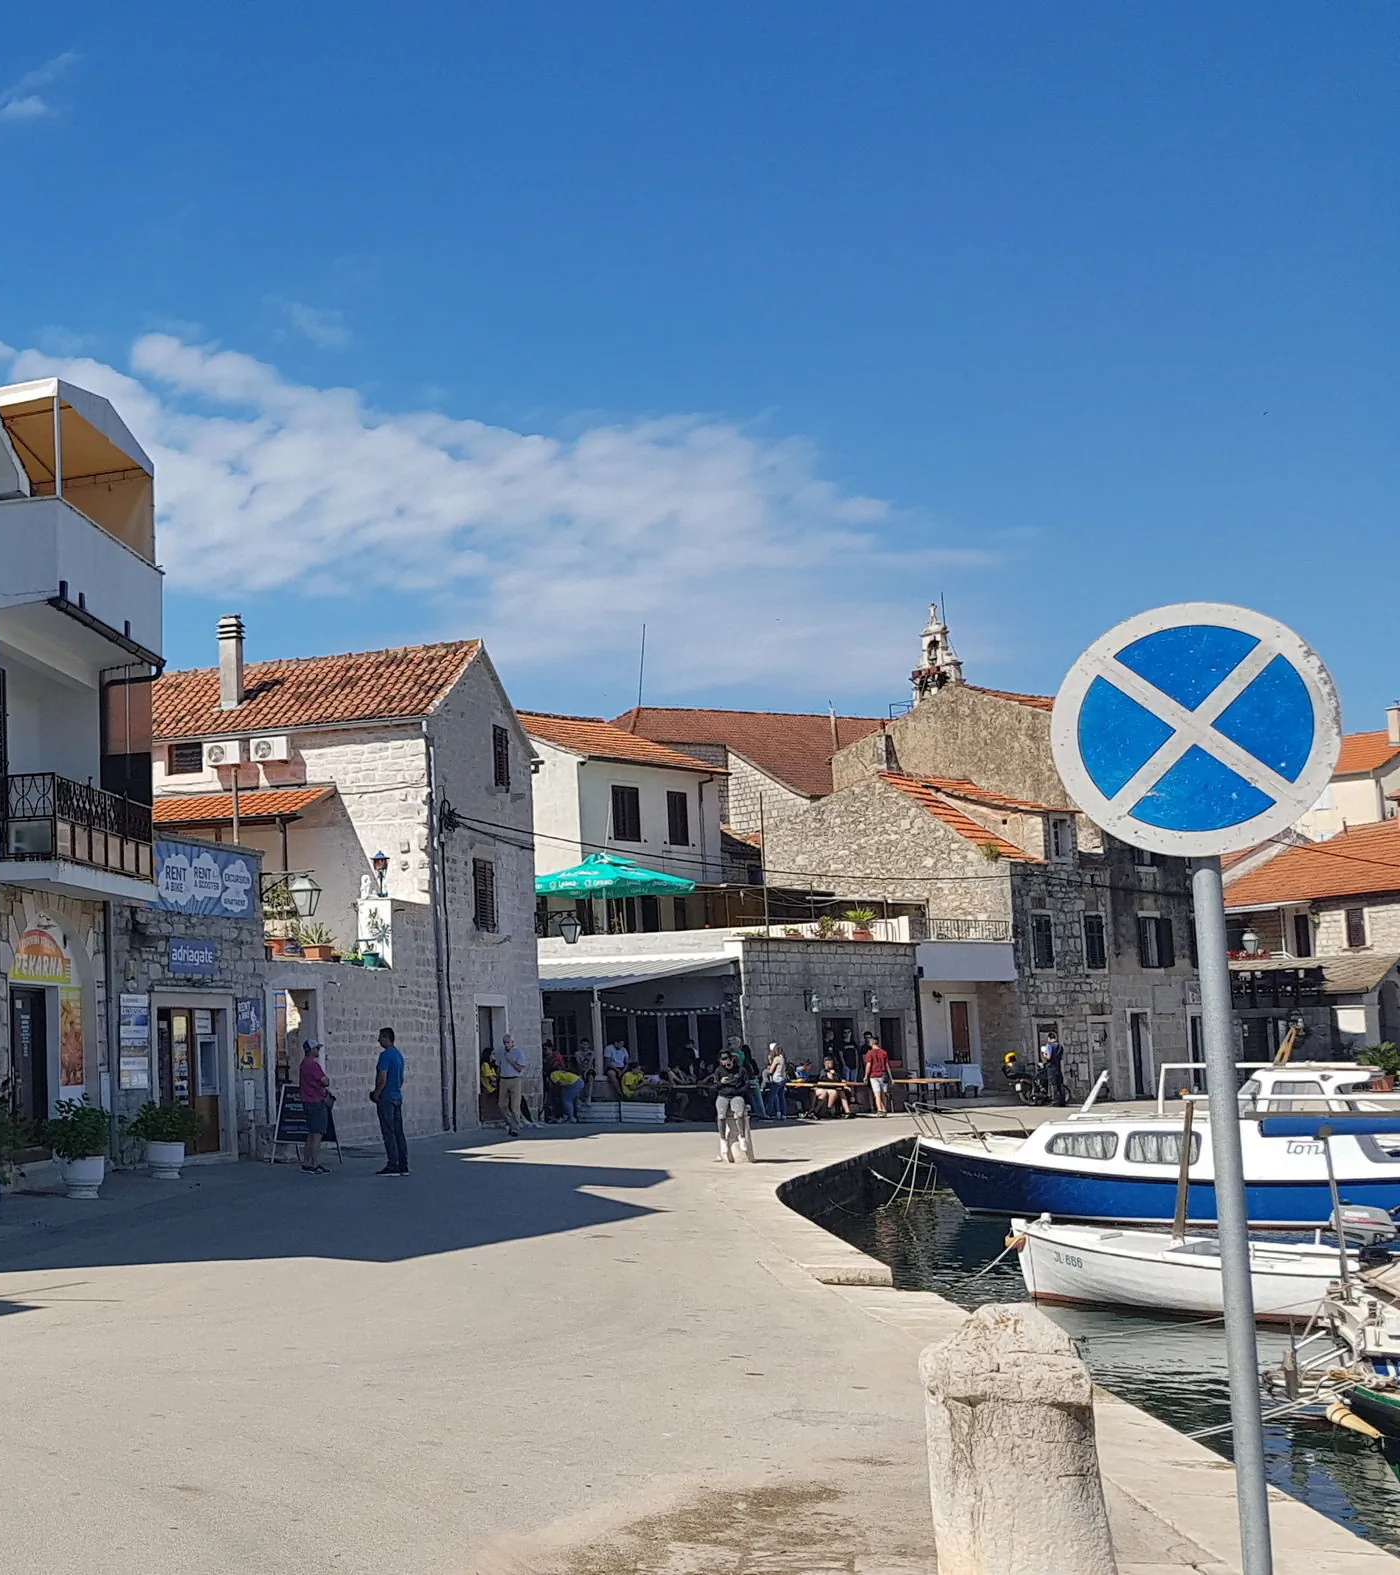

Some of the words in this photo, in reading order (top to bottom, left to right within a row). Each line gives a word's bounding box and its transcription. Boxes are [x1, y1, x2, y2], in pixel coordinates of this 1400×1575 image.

[165, 865, 187, 882] RENT
[193, 866, 211, 880] RENT
[224, 873, 250, 885] EXCURSION
[165, 882, 169, 891] A
[170, 882, 183, 893] BIKE
[194, 880, 198, 888] A
[198, 880, 220, 891] SCOOTER
[171, 945, 213, 966] adriagate
